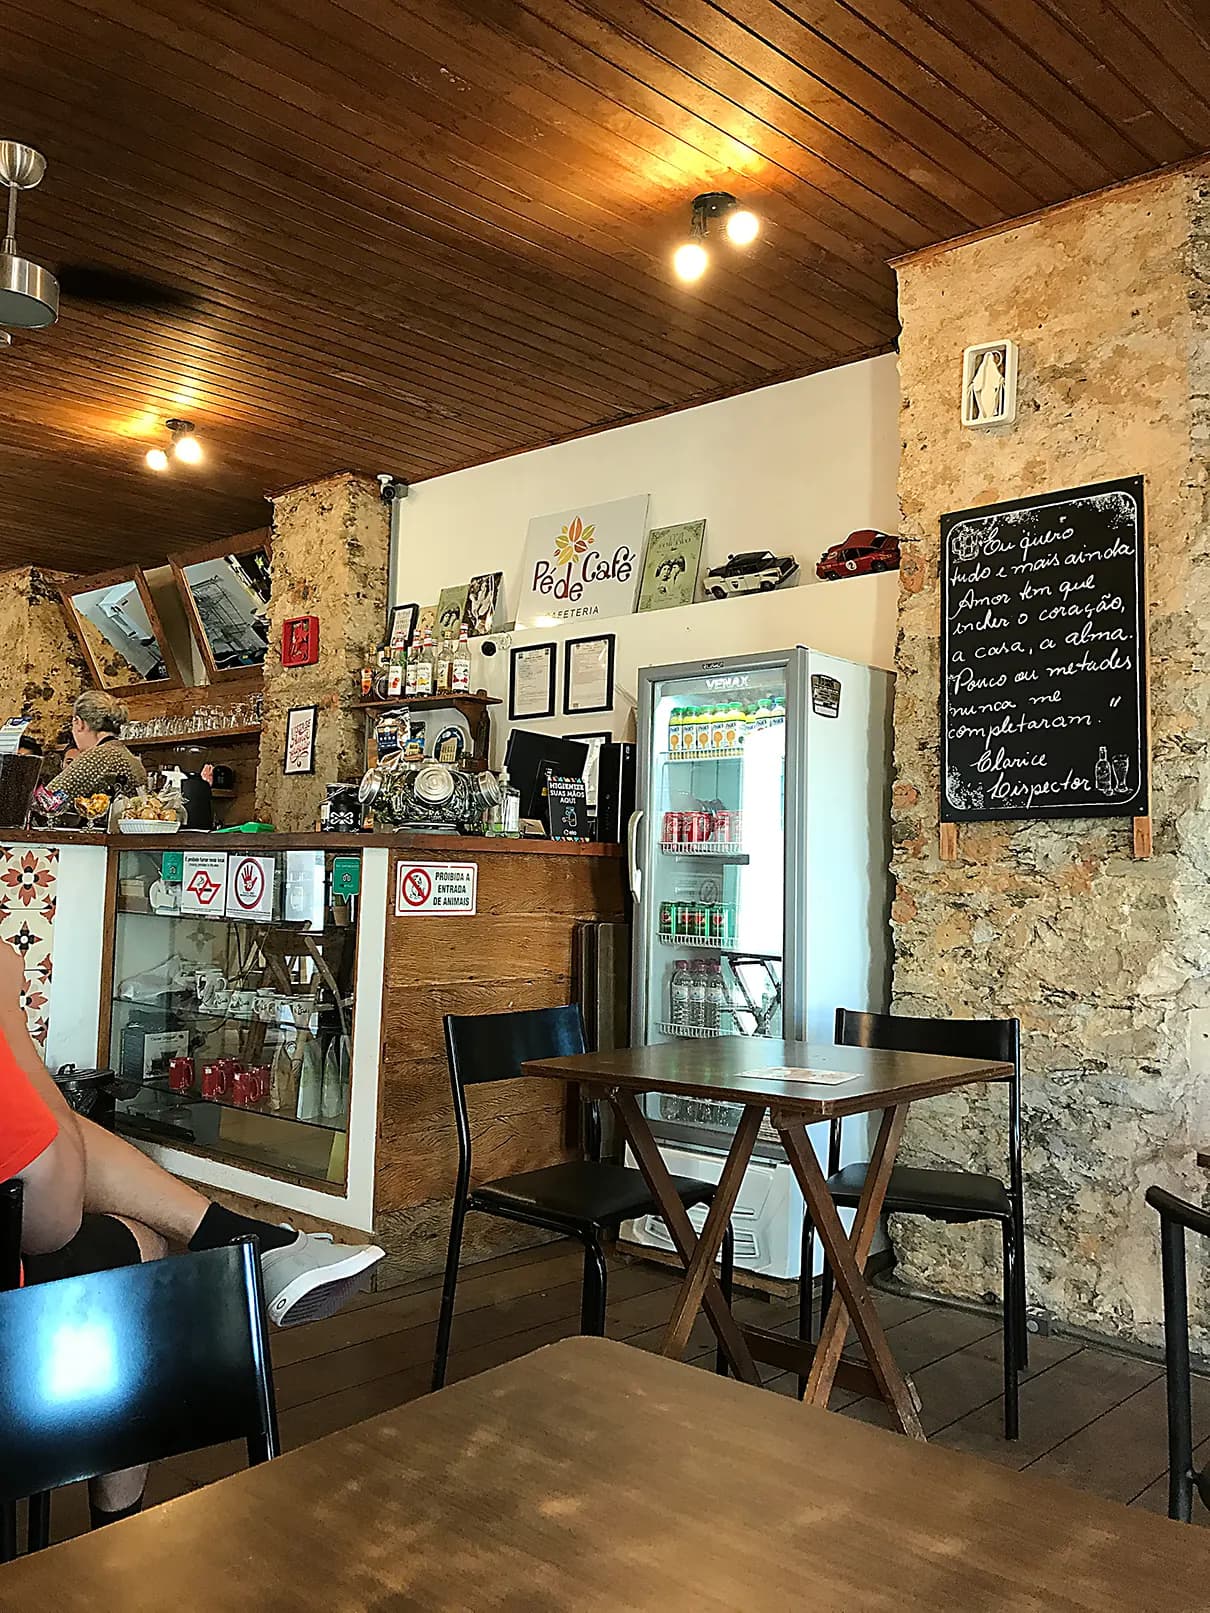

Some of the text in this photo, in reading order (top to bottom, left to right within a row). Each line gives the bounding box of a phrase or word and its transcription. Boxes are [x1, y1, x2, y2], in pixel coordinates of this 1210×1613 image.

[983, 526, 1075, 561] Eu quero
[532, 546, 636, 602] Pé de Café
[950, 537, 1135, 587] tudo e mais ainda
[948, 574, 1096, 620] Amor tem que
[545, 605, 600, 618] AFETERIA
[952, 608, 1011, 636] encher
[1017, 613, 1029, 625] o
[951, 650, 966, 663] a
[1039, 638, 1057, 650] a
[949, 647, 1133, 695] Pouco ou metades
[949, 689, 1062, 717] nunca me
[969, 747, 1048, 773] Clarice
[549, 789, 566, 797] SUAS
[986, 768, 1092, 809] Lispector
[435, 871, 471, 882] PROIBIDA A
[437, 884, 467, 894] ENTRADA
[432, 896, 470, 906] DE ANIMAIS
